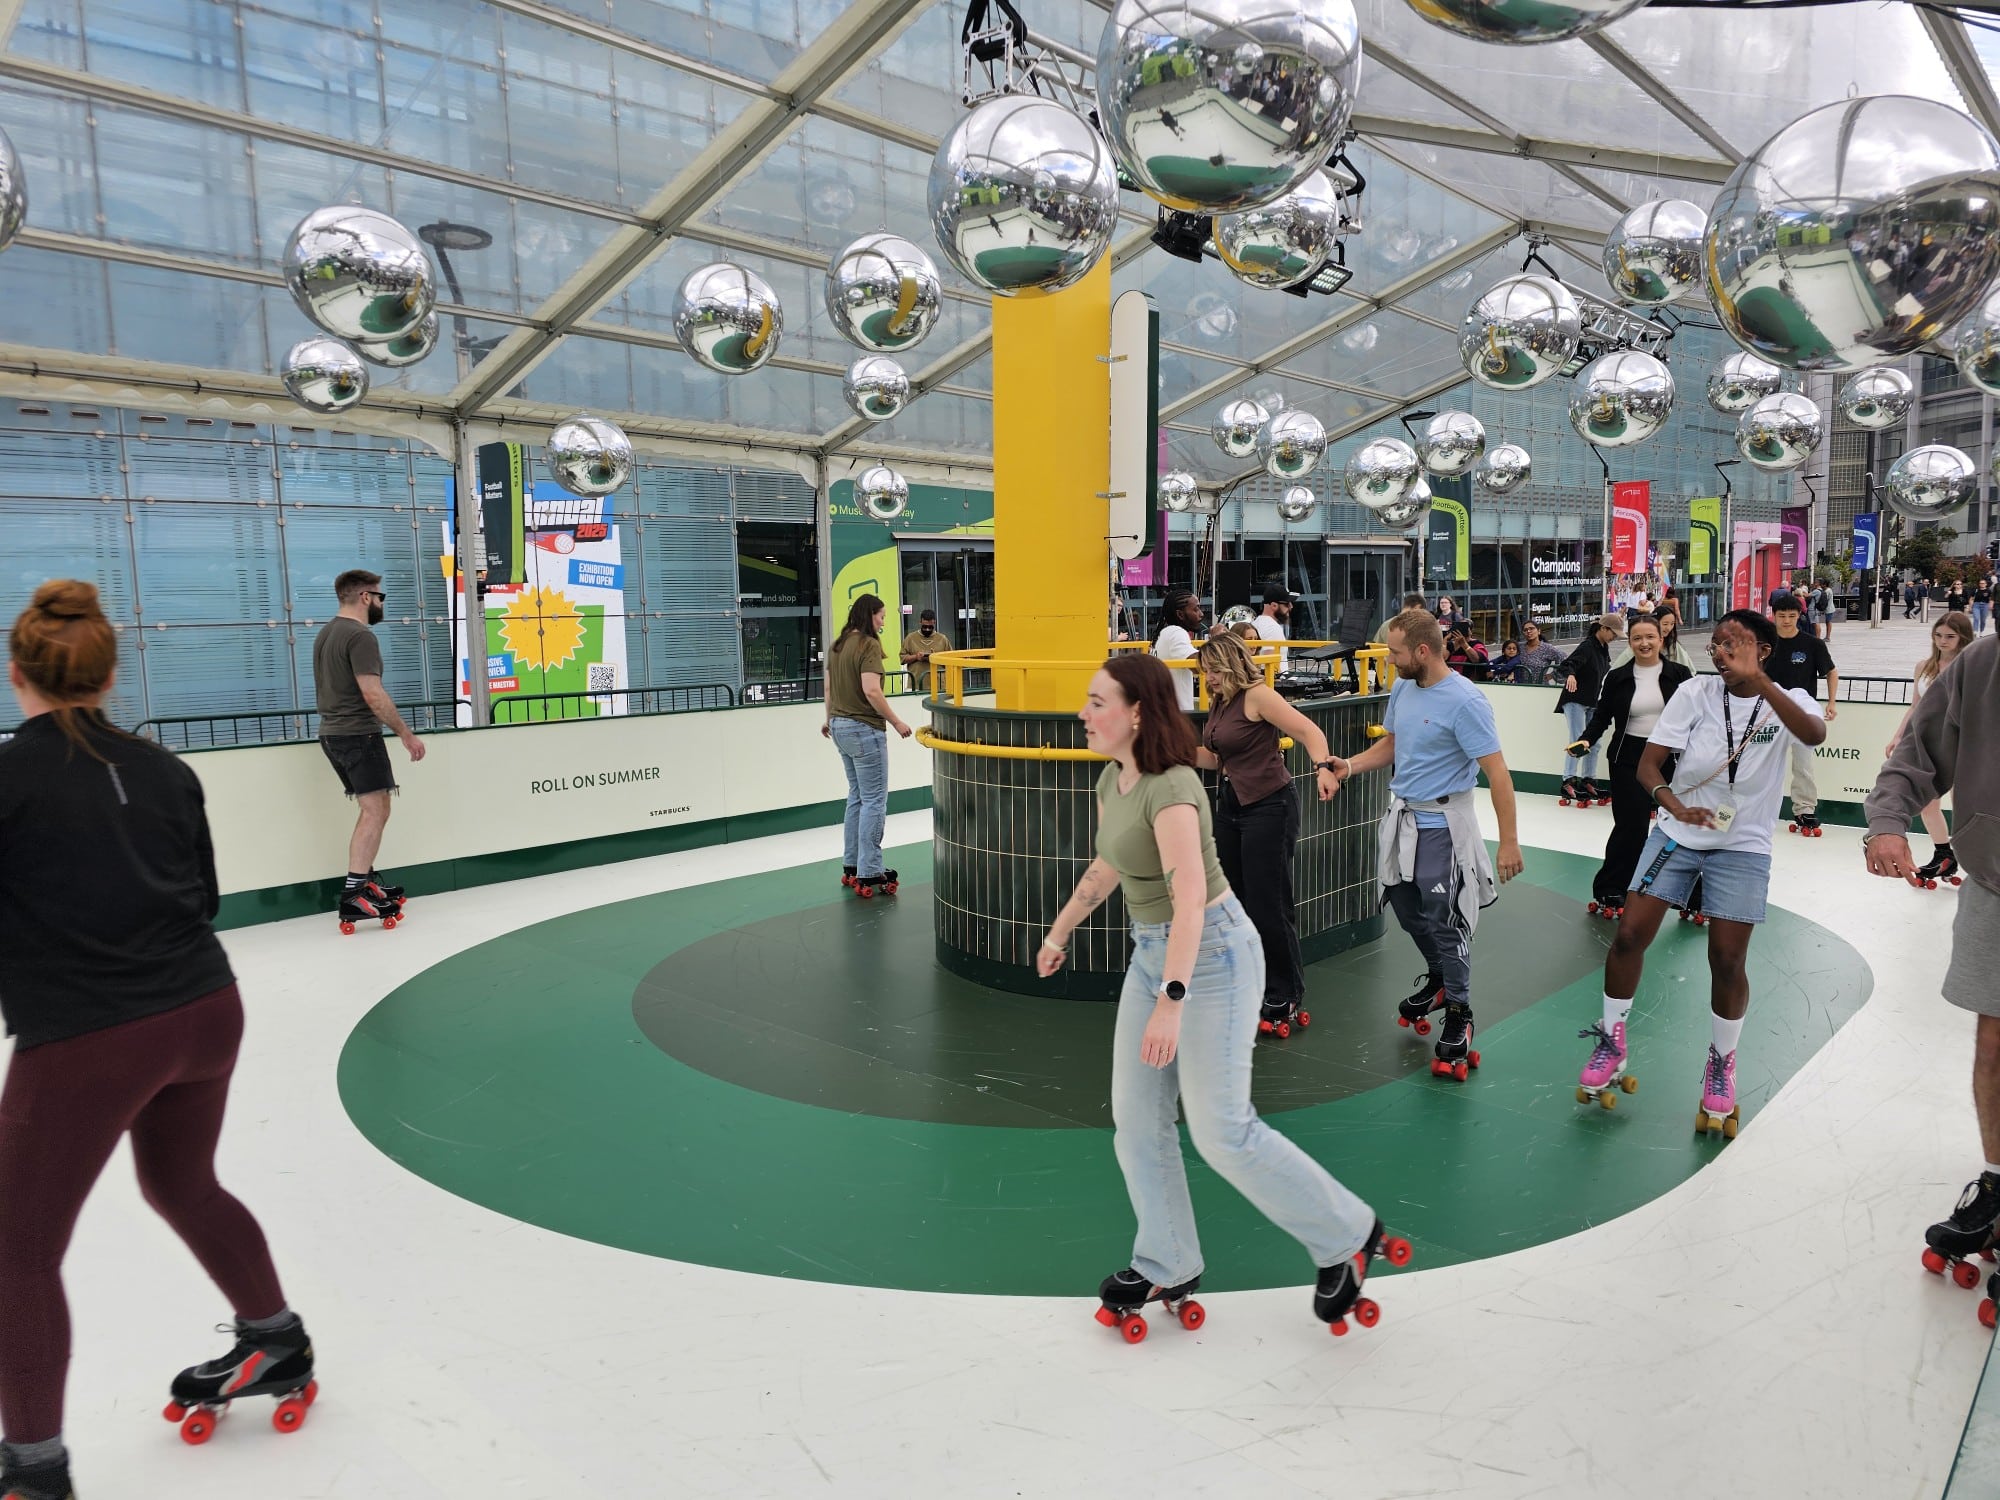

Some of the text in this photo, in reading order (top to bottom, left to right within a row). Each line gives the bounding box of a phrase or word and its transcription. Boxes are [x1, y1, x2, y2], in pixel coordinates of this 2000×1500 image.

[576, 524, 607, 539] 2025
[579, 563, 614, 577] EXHIBITION
[1532, 557, 1580, 576] Champions
[579, 574, 614, 586] NOW OPEN
[1532, 577, 1540, 585] The
[1541, 576, 1561, 585] Lionesses
[1578, 576, 1590, 585] home
[778, 594, 797, 604] shop
[1532, 603, 1551, 613] England
[531, 767, 661, 794] ROLL ON SUMMER
[650, 806, 691, 817] STARBUCKS
